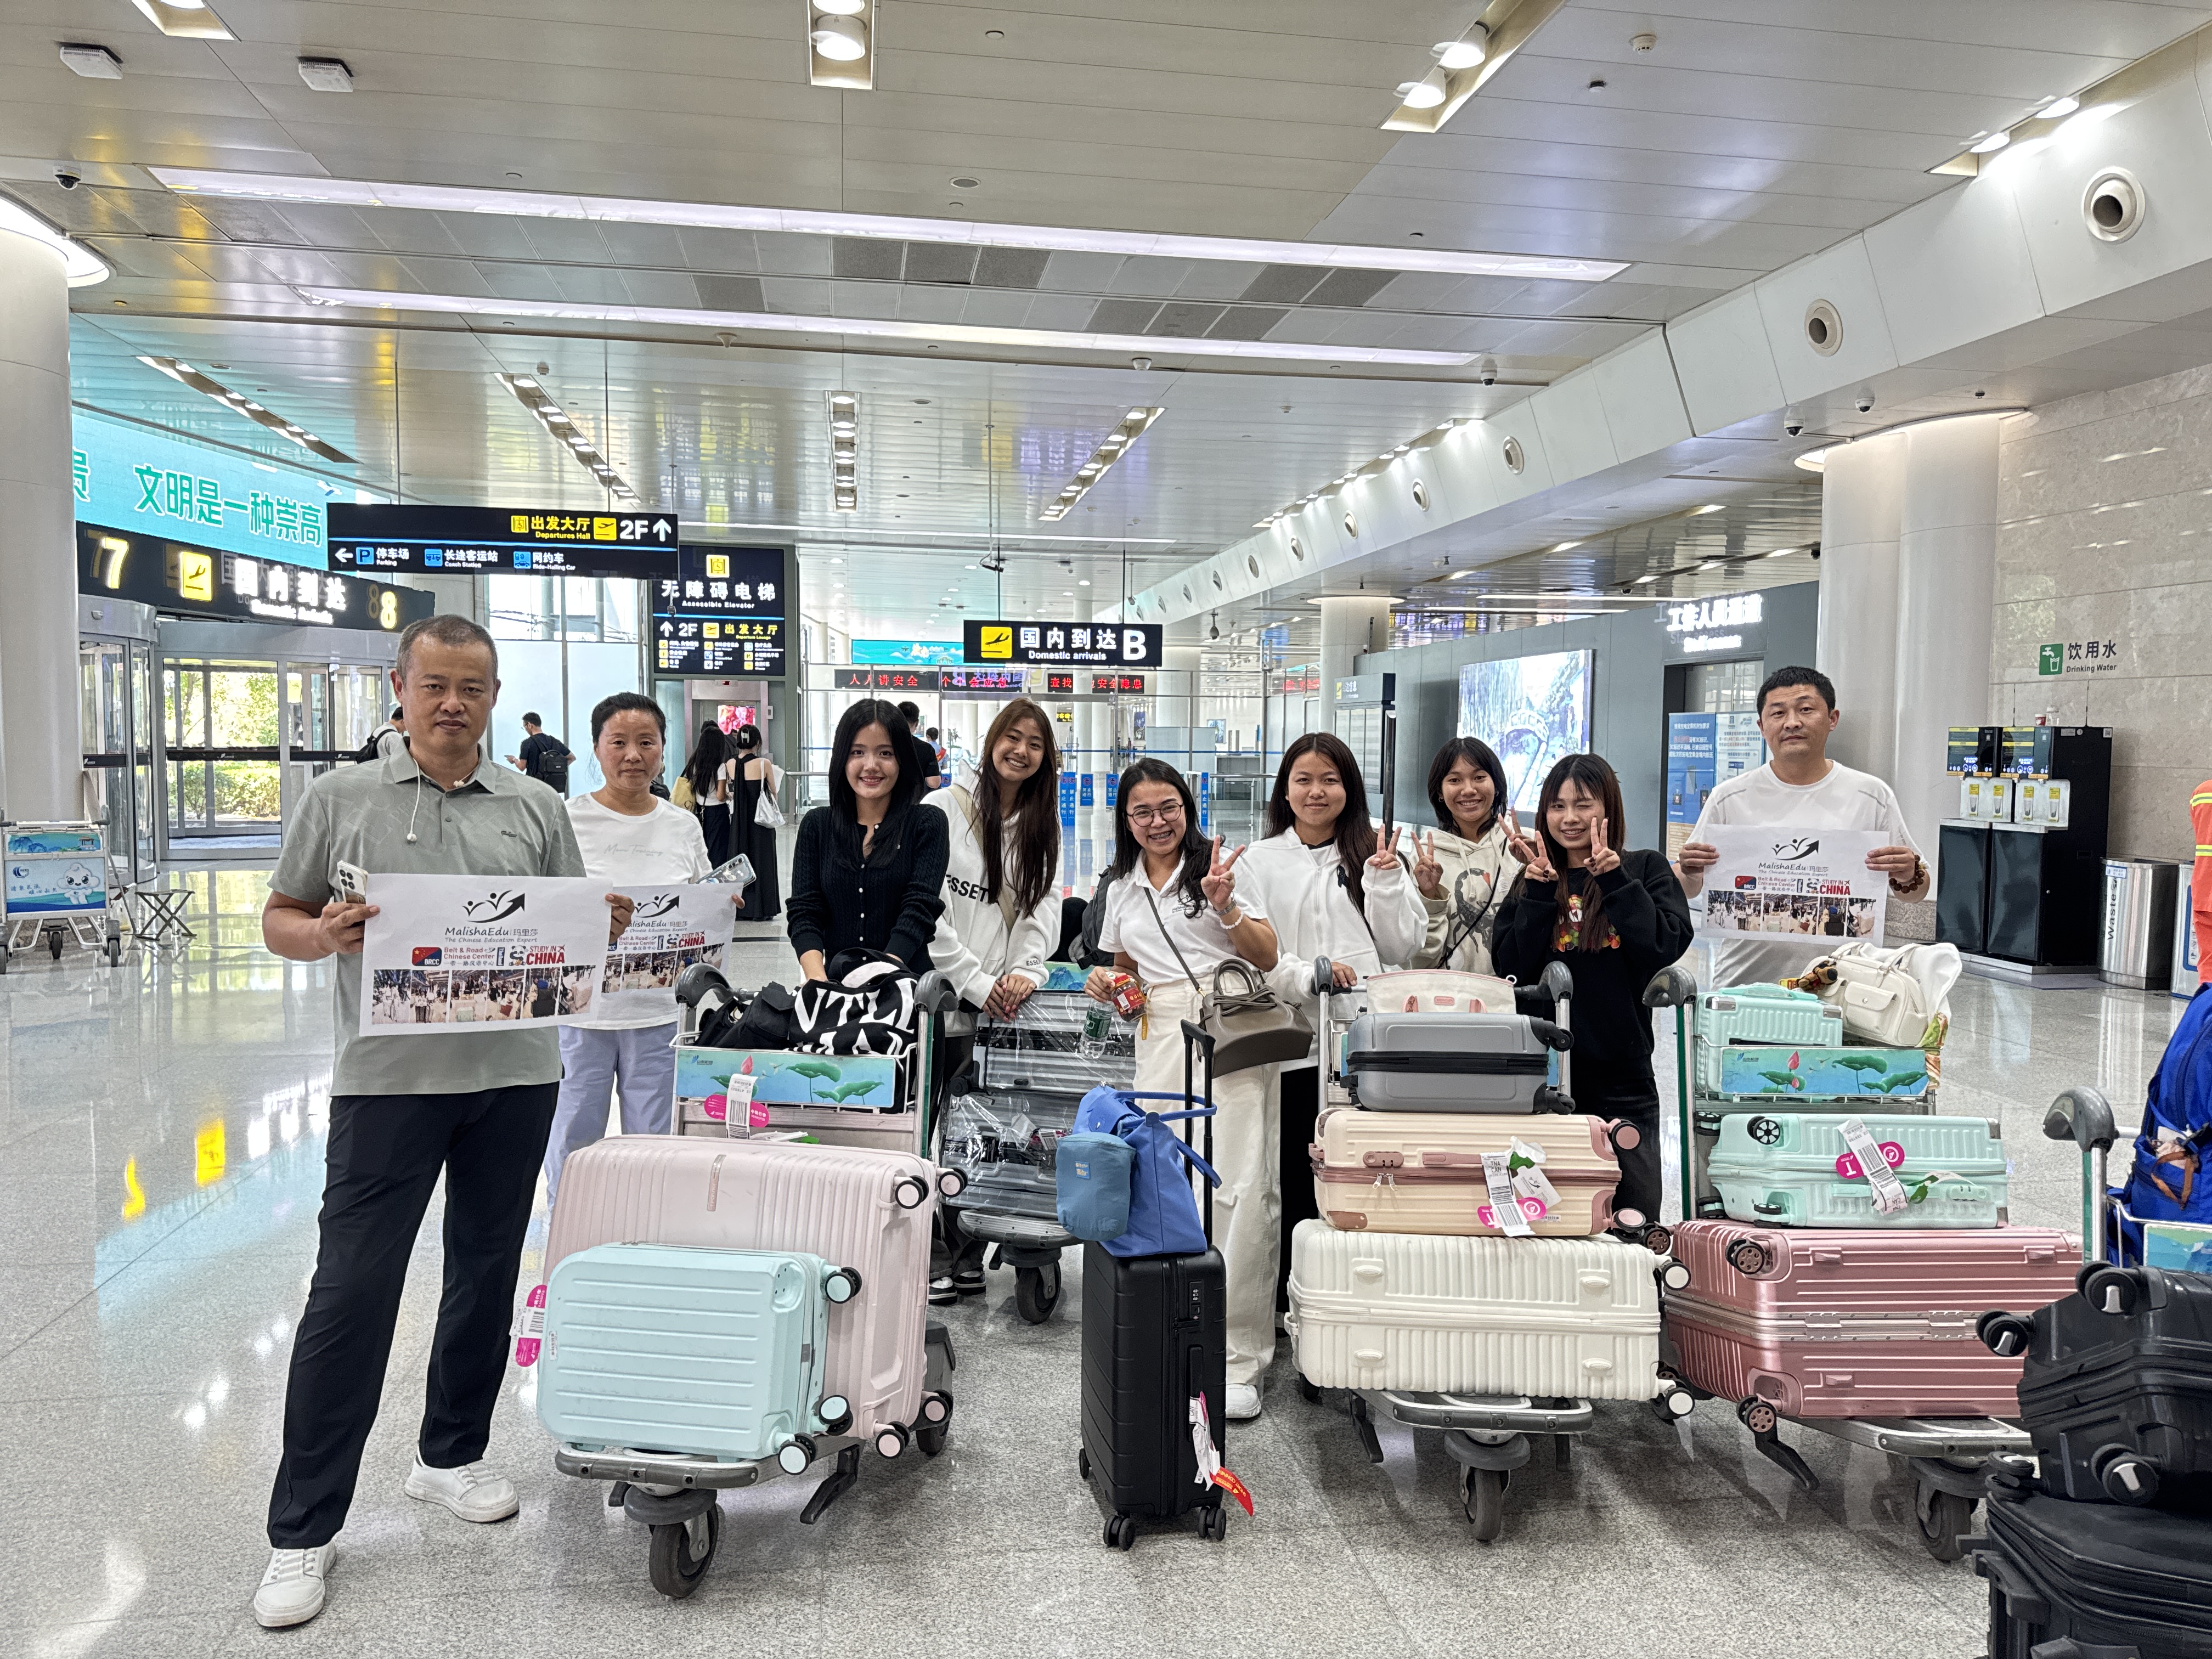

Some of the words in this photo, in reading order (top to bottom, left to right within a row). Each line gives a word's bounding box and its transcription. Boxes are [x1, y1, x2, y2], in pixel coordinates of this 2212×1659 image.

[133, 463, 324, 547] 文明是一种崇高
[531, 516, 590, 531] 出发大厅
[620, 520, 648, 540] 2F
[535, 531, 575, 539] Departures
[376, 548, 409, 560] 停车场
[444, 550, 498, 562] 长途客运站
[533, 552, 564, 564] 网约车
[101, 537, 129, 589] 7
[661, 580, 776, 601] 无障碍电梯
[380, 591, 397, 629] 8
[678, 623, 698, 637] 2F
[725, 623, 778, 635] 出发大厅
[1020, 627, 1117, 650] 国内到达
[1123, 629, 1147, 661] B
[1029, 650, 1070, 660] Domestic
[1073, 651, 1107, 661] arrivals
[2068, 640, 2117, 661] 饮用水
[850, 674, 918, 687] 人人讲安全
[1758, 862, 1806, 871] MalishaEdu
[1819, 884, 1851, 895] CHINA
[2107, 894, 2117, 940] Waste
[445, 927, 509, 936] MalishaEdu
[513, 928, 538, 936] 玛里莎
[678, 936, 705, 948] CHINA
[526, 952, 565, 965] CHINA
[1235, 1482, 1246, 1497] SHORT
